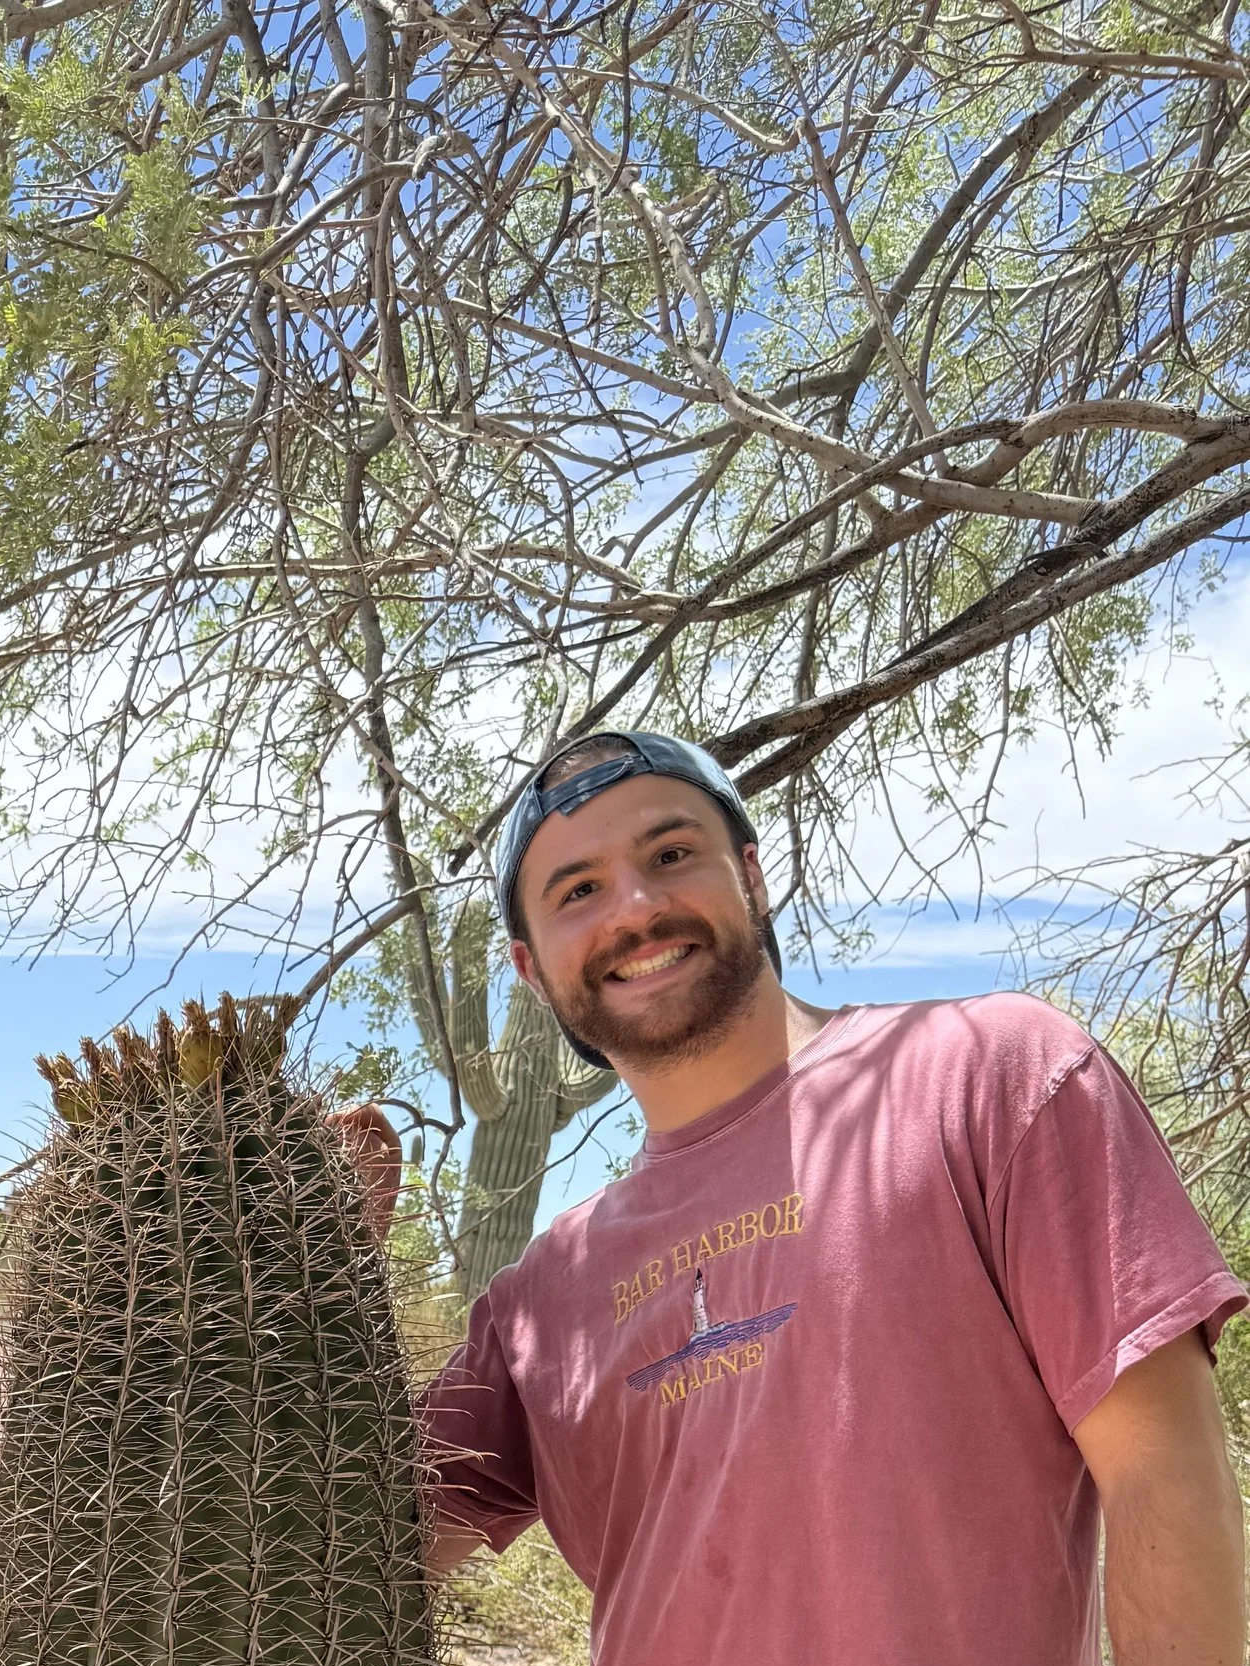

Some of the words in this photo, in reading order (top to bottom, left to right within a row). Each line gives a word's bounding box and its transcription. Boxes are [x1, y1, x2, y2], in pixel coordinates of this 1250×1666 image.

[612, 1258, 665, 1325] BAR
[670, 1193, 805, 1277] HARBOR
[659, 1342, 764, 1408] MAINE
